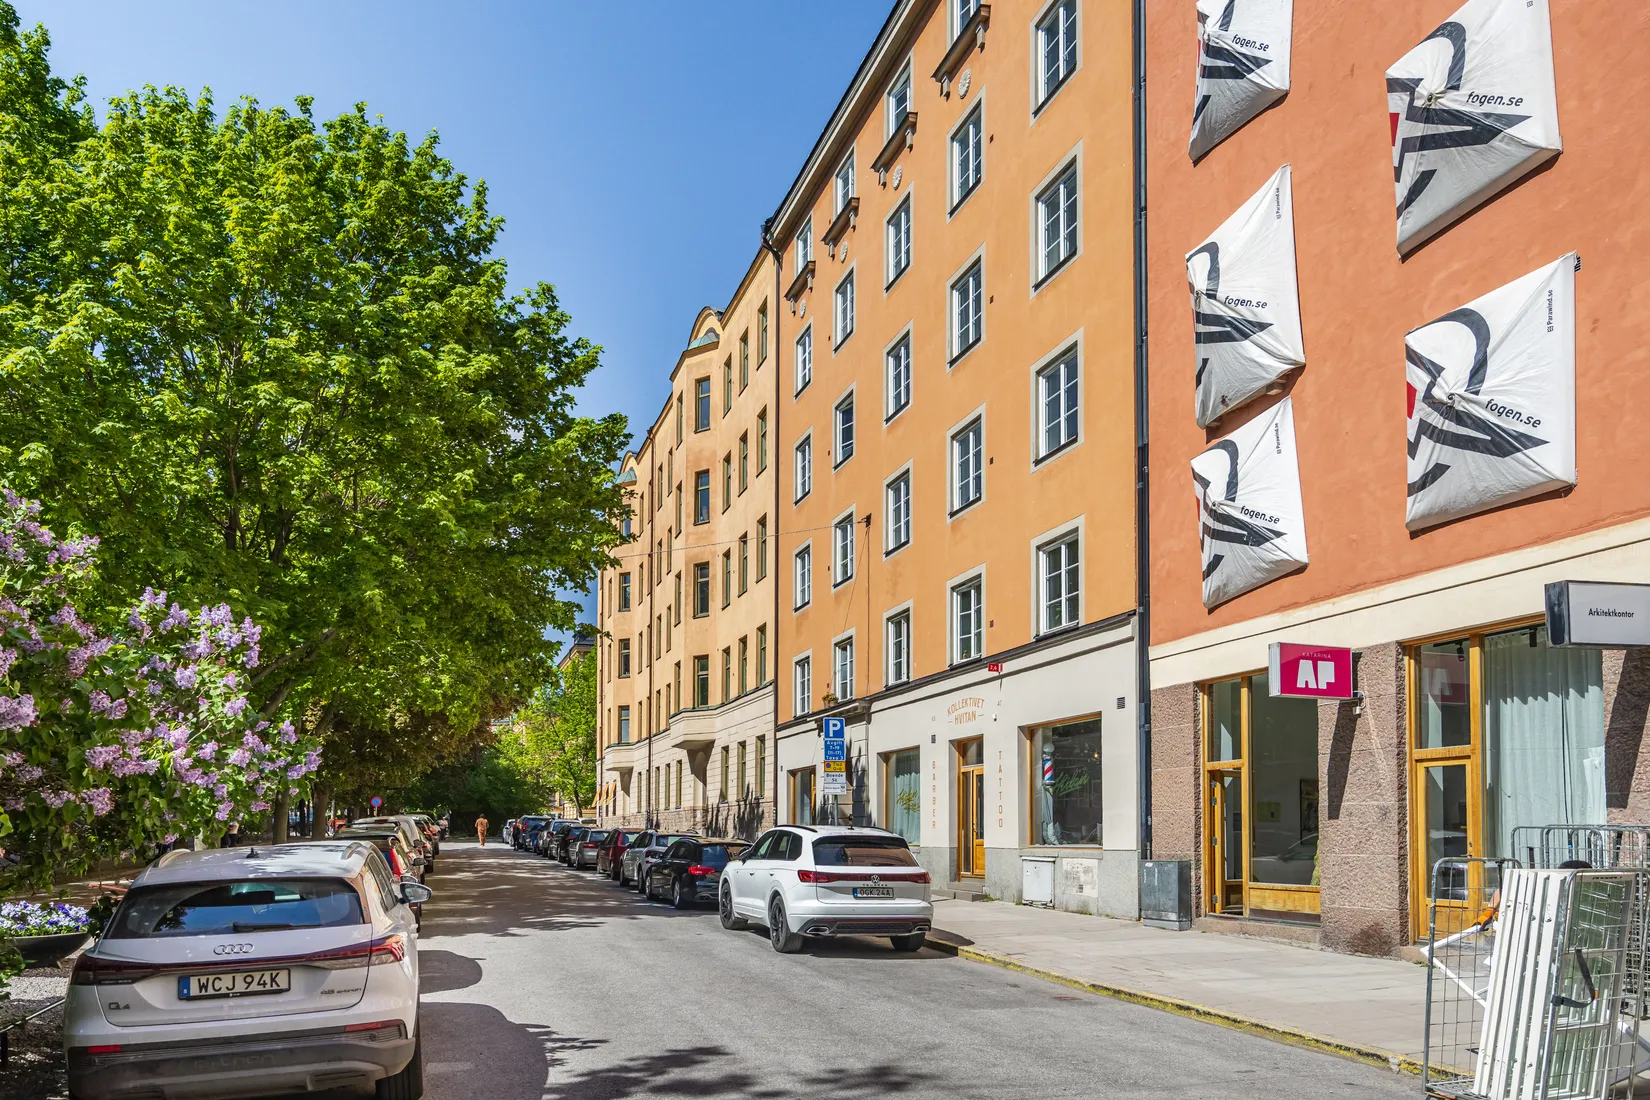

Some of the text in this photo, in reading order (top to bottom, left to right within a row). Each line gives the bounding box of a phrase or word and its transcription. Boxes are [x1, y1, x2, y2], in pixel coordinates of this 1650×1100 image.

[1232, 34, 1269, 51] fogen.se
[1466, 91, 1523, 106] fogen.se
[1223, 295, 1268, 309] fogen.se
[1485, 398, 1541, 428] fogen.se
[1240, 505, 1280, 524] fogen.se
[1588, 608, 1634, 618] Arkitektkontor
[1296, 659, 1335, 689] AP
[947, 697, 984, 716] KOLLEKTIVET
[955, 710, 976, 725] HVITAN
[829, 720, 841, 737] P
[876, 888, 891, 896] 24A
[198, 972, 281, 993] WCJ 94K
[108, 1002, 130, 1010] Q4
